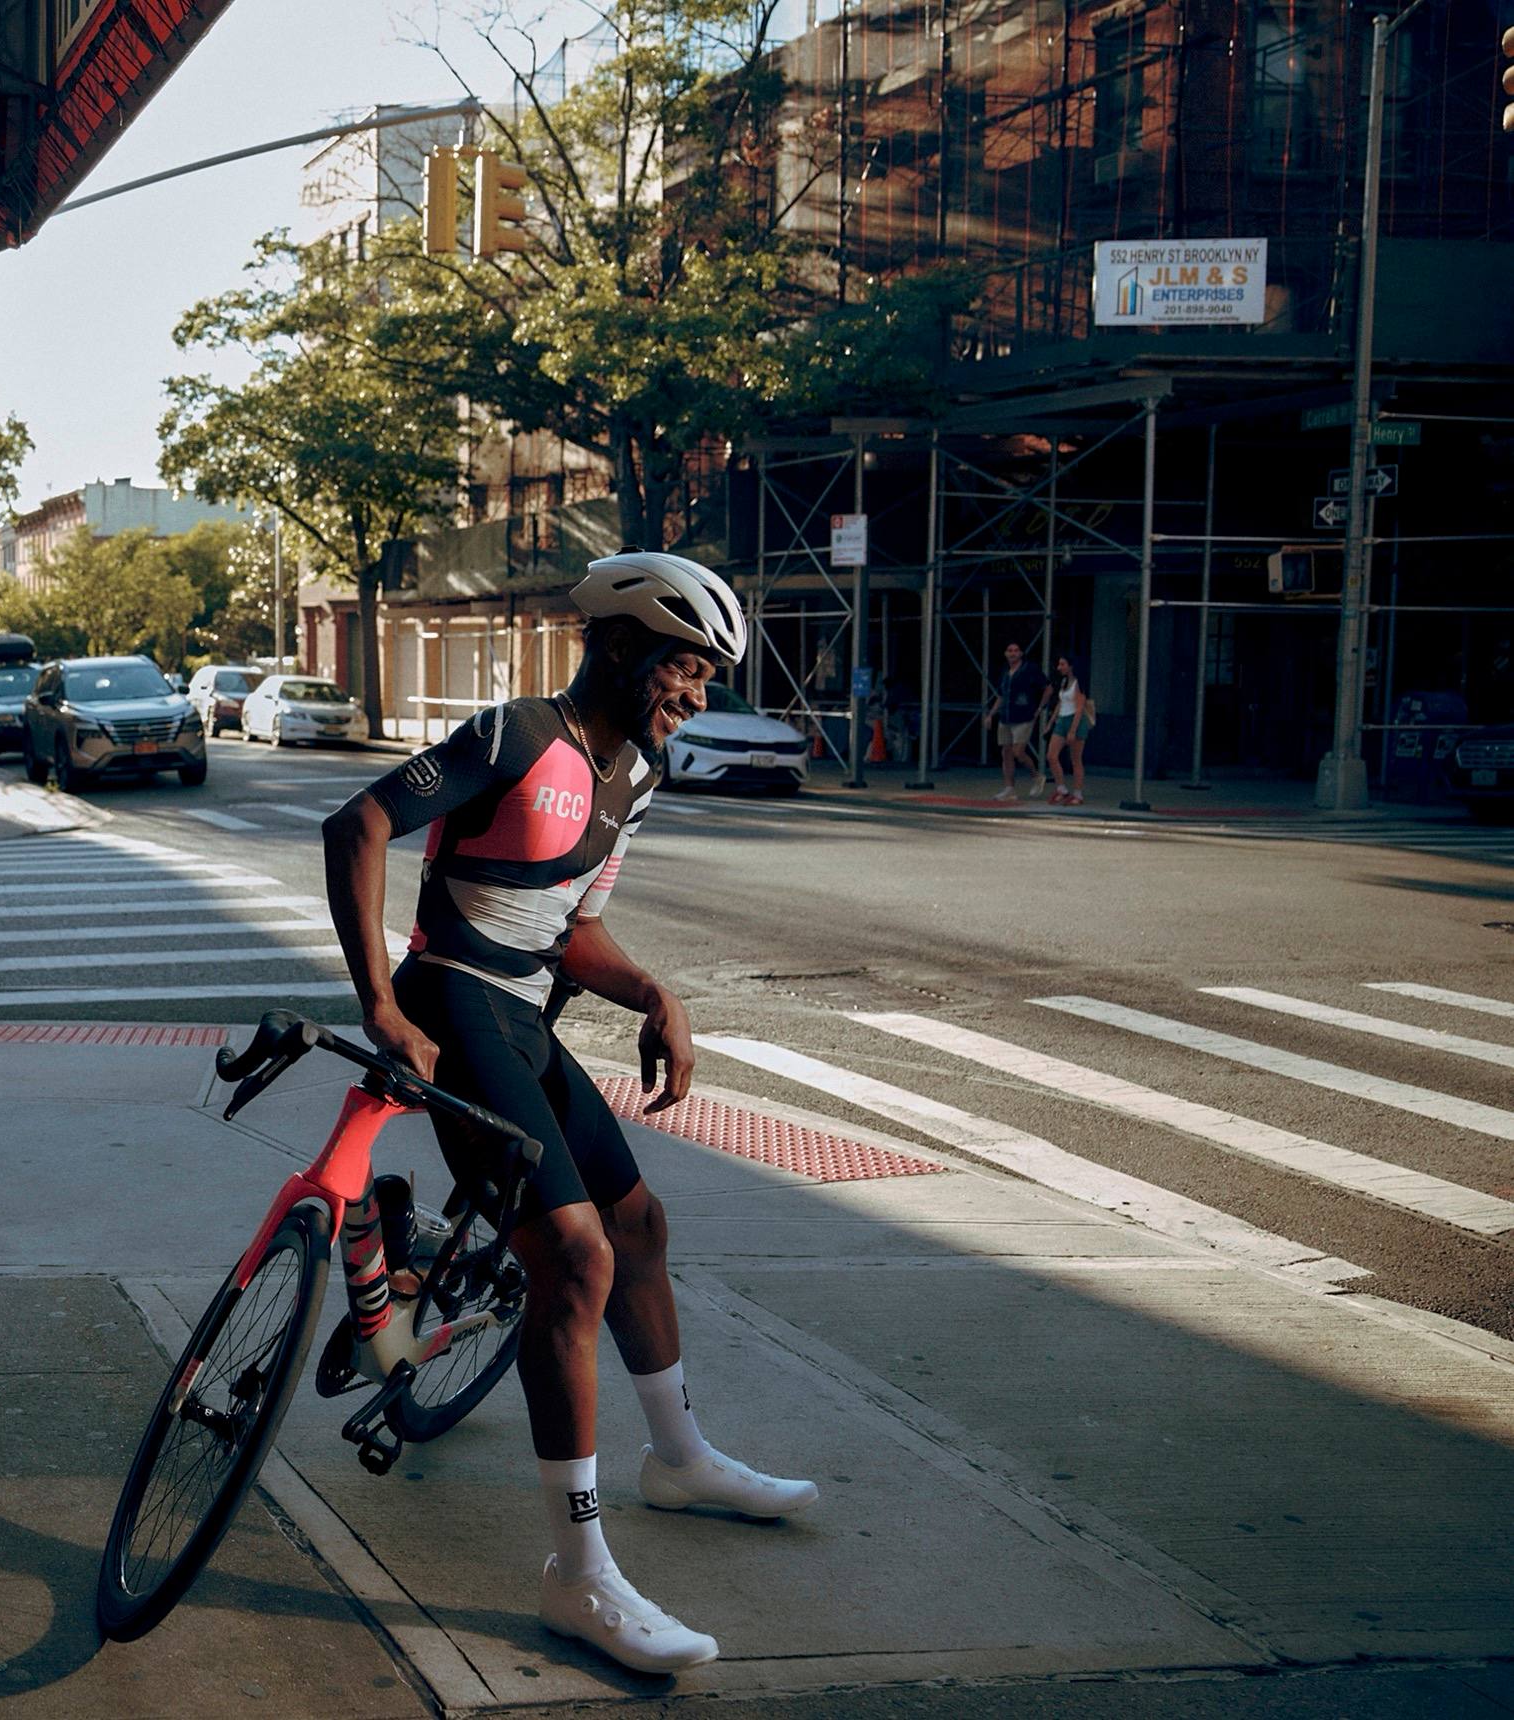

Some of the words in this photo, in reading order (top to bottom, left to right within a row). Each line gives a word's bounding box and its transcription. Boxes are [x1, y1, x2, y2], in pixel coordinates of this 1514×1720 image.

[1110, 249, 1128, 265] 552
[1130, 249, 1165, 264] HENRY
[1168, 249, 1182, 264] ST
[1185, 248, 1243, 264] BROOKLYN
[1244, 248, 1260, 263] NY
[1149, 266, 1199, 286] JLM
[1206, 266, 1224, 285] &
[1232, 266, 1249, 285] S
[1152, 288, 1245, 302] ENTERPRISES
[1373, 425, 1406, 445] Henry
[533, 787, 585, 822] RCC
[598, 810, 620, 830] Rapha
[451, 1318, 489, 1344] MONZA
